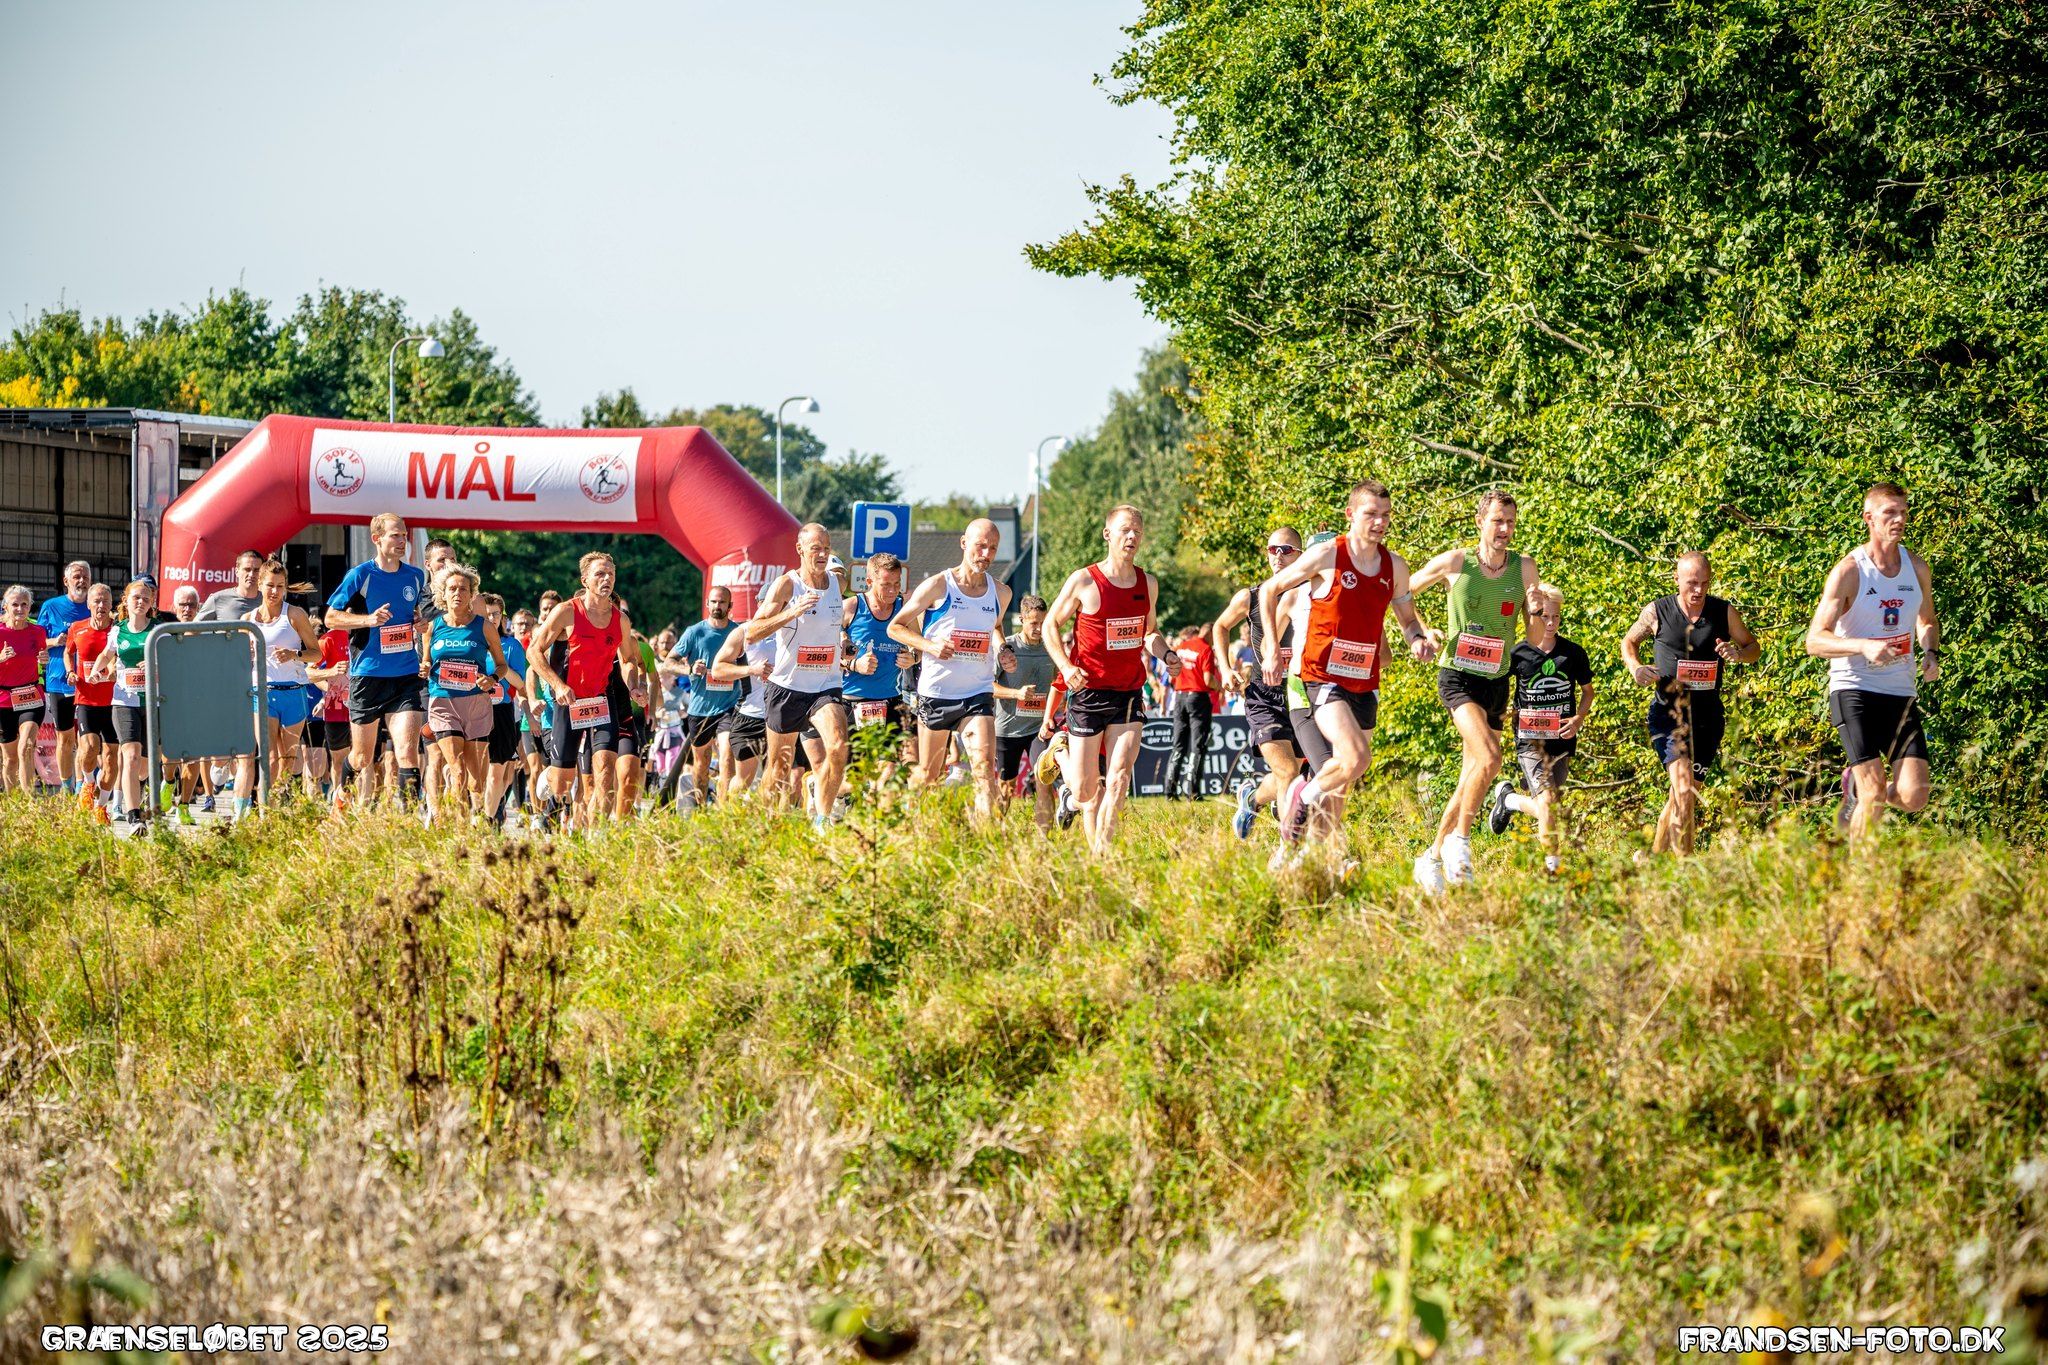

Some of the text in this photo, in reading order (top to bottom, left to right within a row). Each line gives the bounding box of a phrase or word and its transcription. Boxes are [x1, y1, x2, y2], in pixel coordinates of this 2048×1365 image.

[324, 449, 347, 463] BOV
[407, 441, 536, 502] MÅL
[336, 478, 361, 496] MOTION
[864, 508, 898, 554] P
[164, 565, 190, 581] race
[389, 632, 407, 642] 2894
[1117, 626, 1138, 637] 2824
[445, 639, 477, 648] bpure
[960, 639, 982, 649] 2827
[1460, 635, 1504, 648] GRÆNSELØBET
[806, 653, 828, 662] 2869
[1340, 651, 1366, 664] 2809
[1467, 645, 1492, 658] 2861
[448, 670, 468, 680] 2884
[1687, 669, 1709, 678] 2753
[578, 706, 600, 717] 2873
